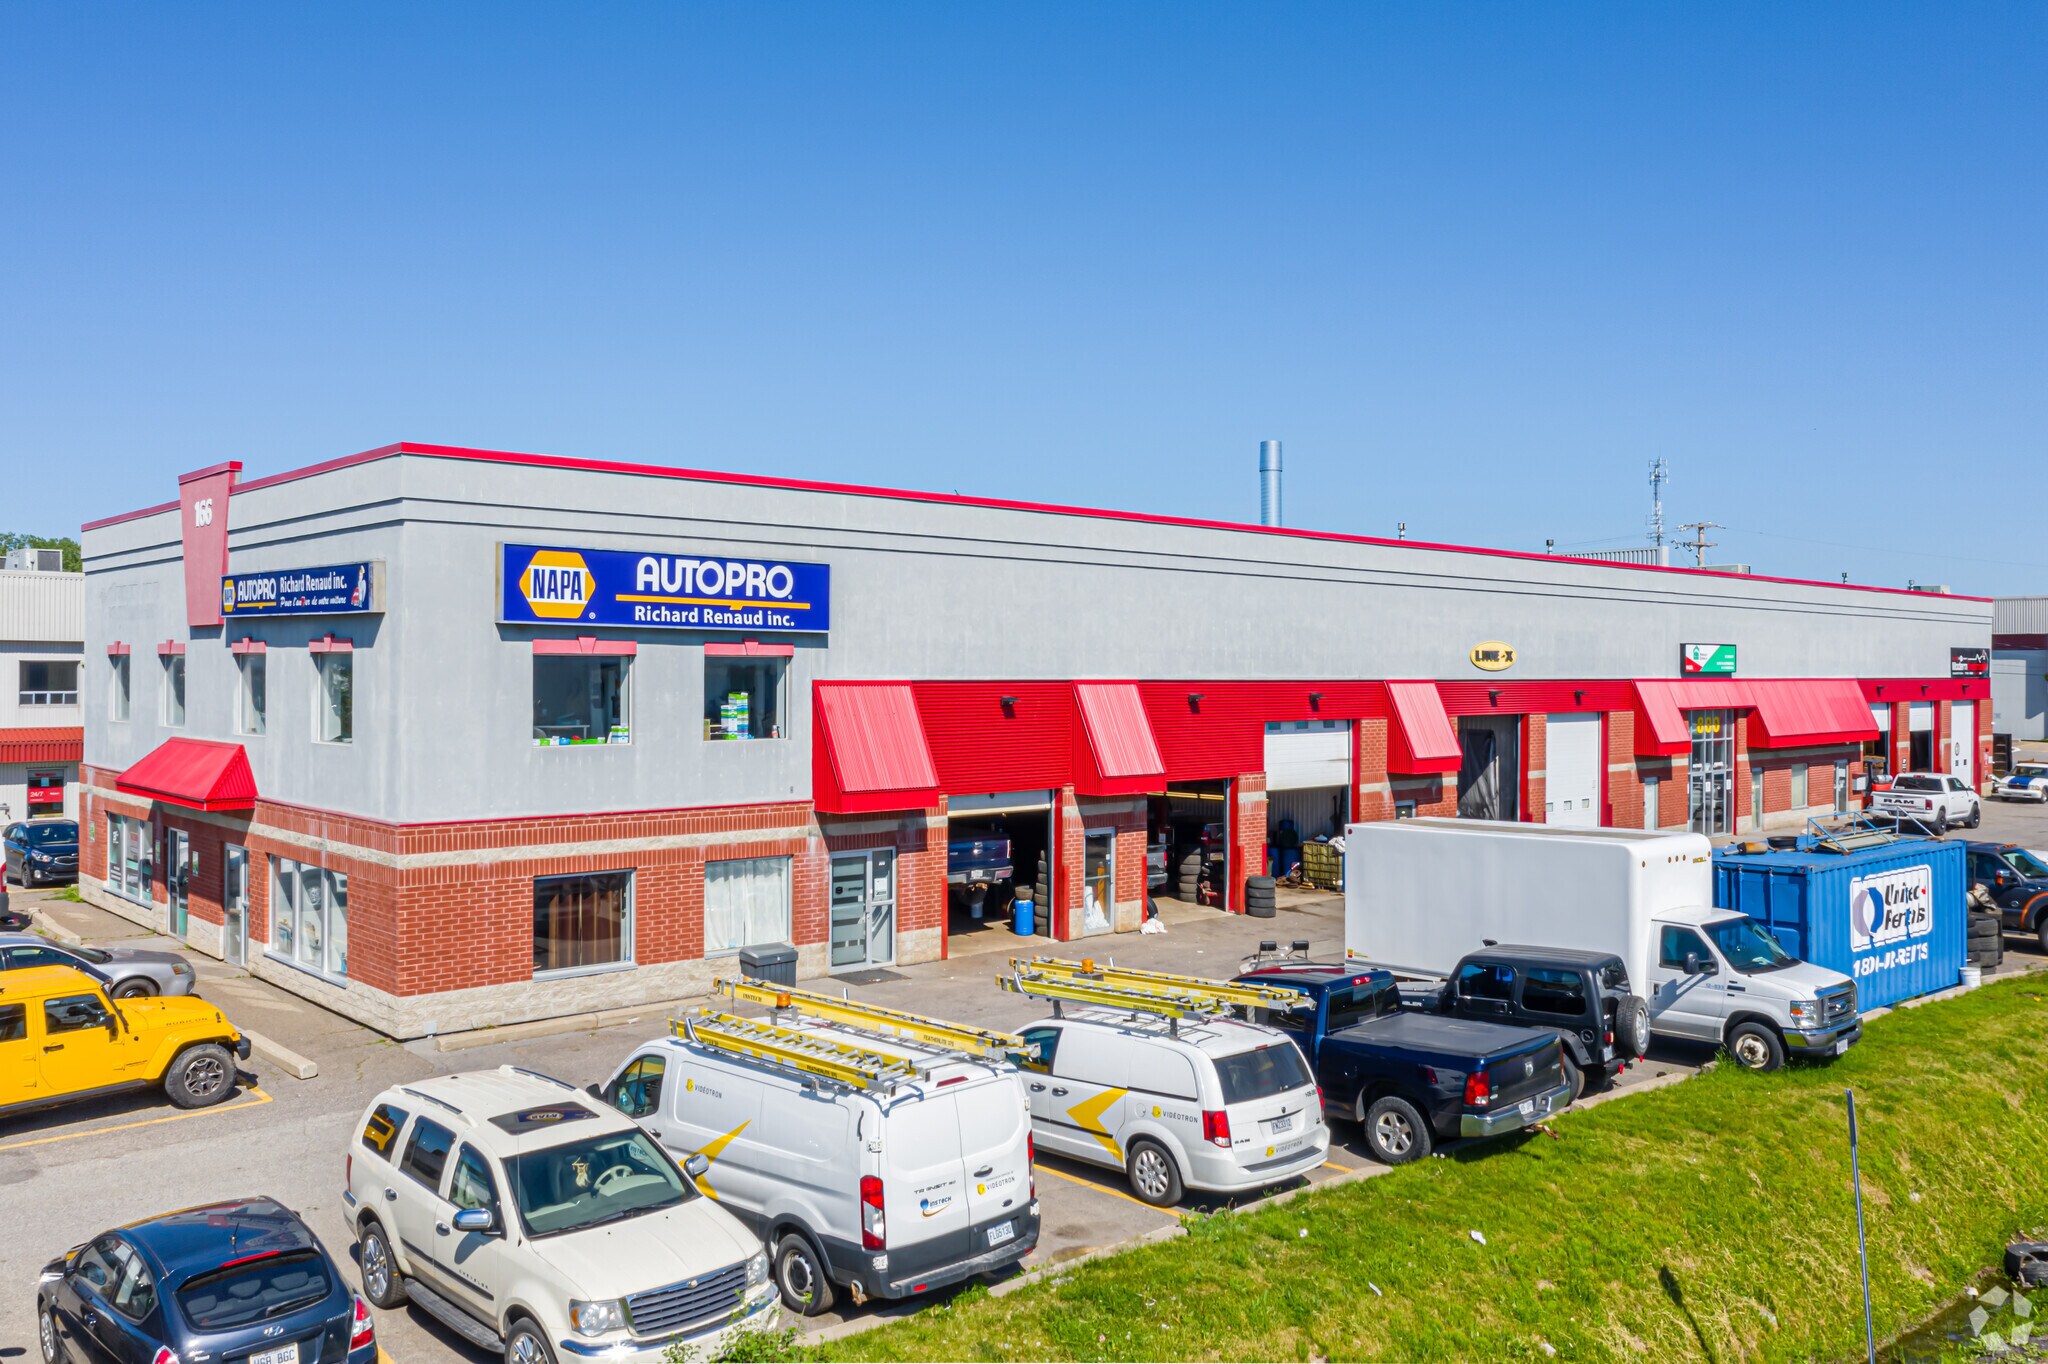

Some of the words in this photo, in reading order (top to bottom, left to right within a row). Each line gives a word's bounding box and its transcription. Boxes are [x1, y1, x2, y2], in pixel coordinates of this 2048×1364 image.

[194, 498, 213, 528] 166
[237, 577, 277, 602] AUTOPRO
[280, 574, 305, 593] Richard
[306, 572, 332, 591] Renaud
[333, 571, 348, 590] inc.
[532, 568, 583, 601] NAPA
[636, 556, 794, 599] AUTOPRO
[635, 605, 700, 624] Richard
[704, 606, 764, 626] Renaud
[767, 610, 795, 627] inc.
[1696, 716, 1720, 734] 800
